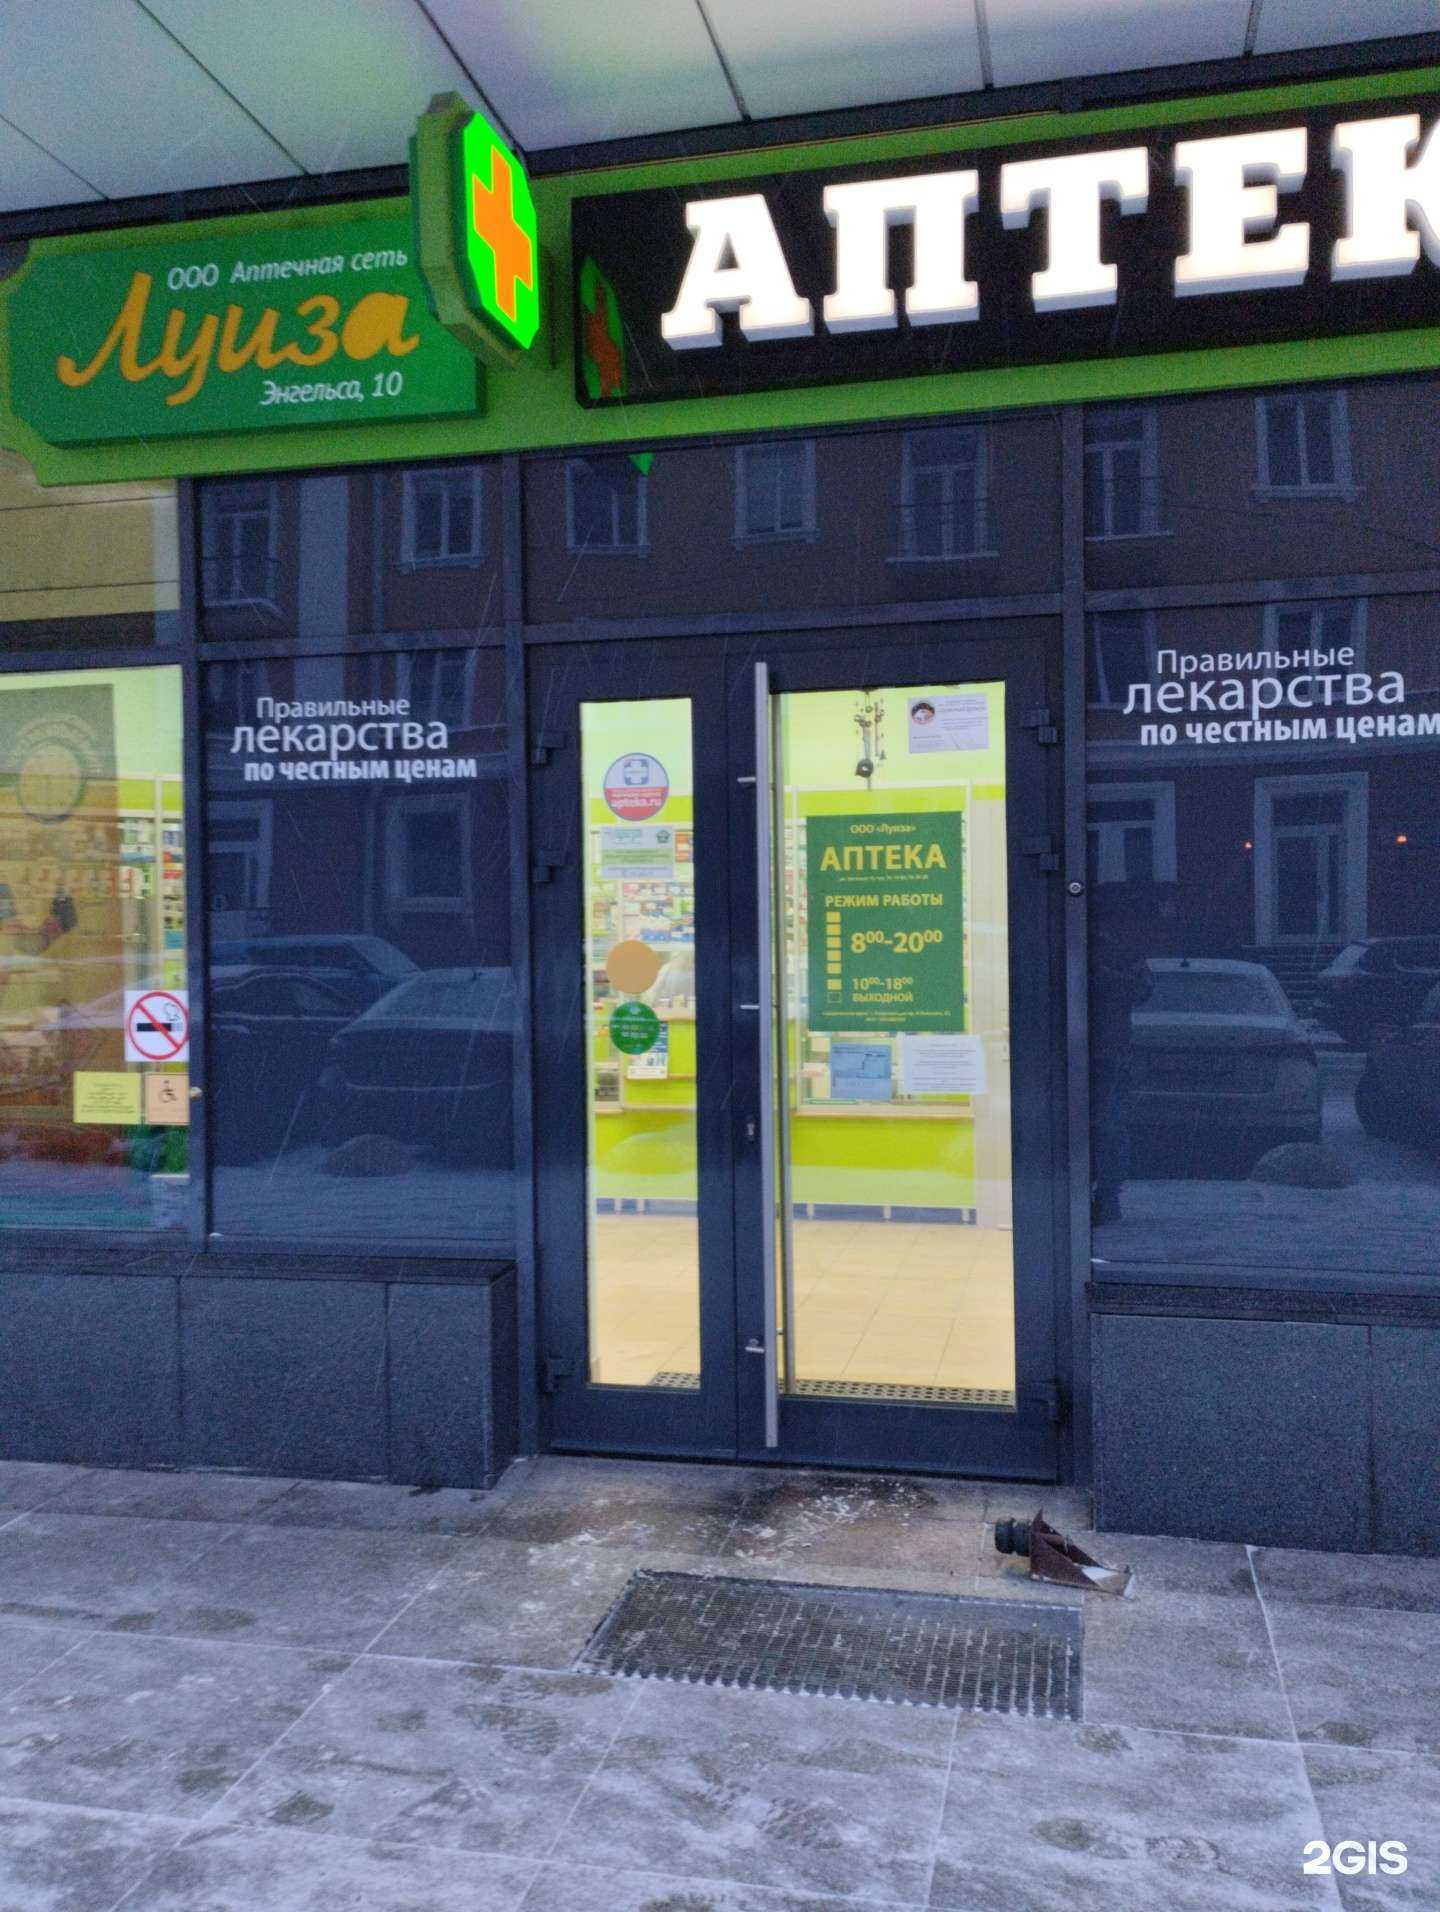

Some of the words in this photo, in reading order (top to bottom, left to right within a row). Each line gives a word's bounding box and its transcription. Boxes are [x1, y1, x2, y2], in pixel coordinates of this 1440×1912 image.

[661, 112, 1440, 350] АПТЕК
[167, 264, 220, 291] ООО
[229, 254, 345, 284] Аптечная
[350, 248, 408, 272] сеть
[55, 271, 421, 407] Луиза
[259, 377, 365, 406] Энгельса,
[370, 370, 404, 398] 10
[1156, 646, 1355, 679] Правильные
[256, 696, 411, 723] Правильные
[1122, 670, 1406, 721] лекарства
[229, 720, 449, 762] лекарства
[1140, 723, 1178, 746] по
[1185, 717, 1327, 744] честным
[1335, 712, 1440, 744] ценам
[244, 762, 275, 781] по
[278, 759, 390, 781] честным
[394, 757, 478, 784] ценам
[819, 843, 948, 872] АПТЕКА
[825, 894, 880, 908] РЕЖИМ
[882, 893, 944, 907] РАБОТЫ
